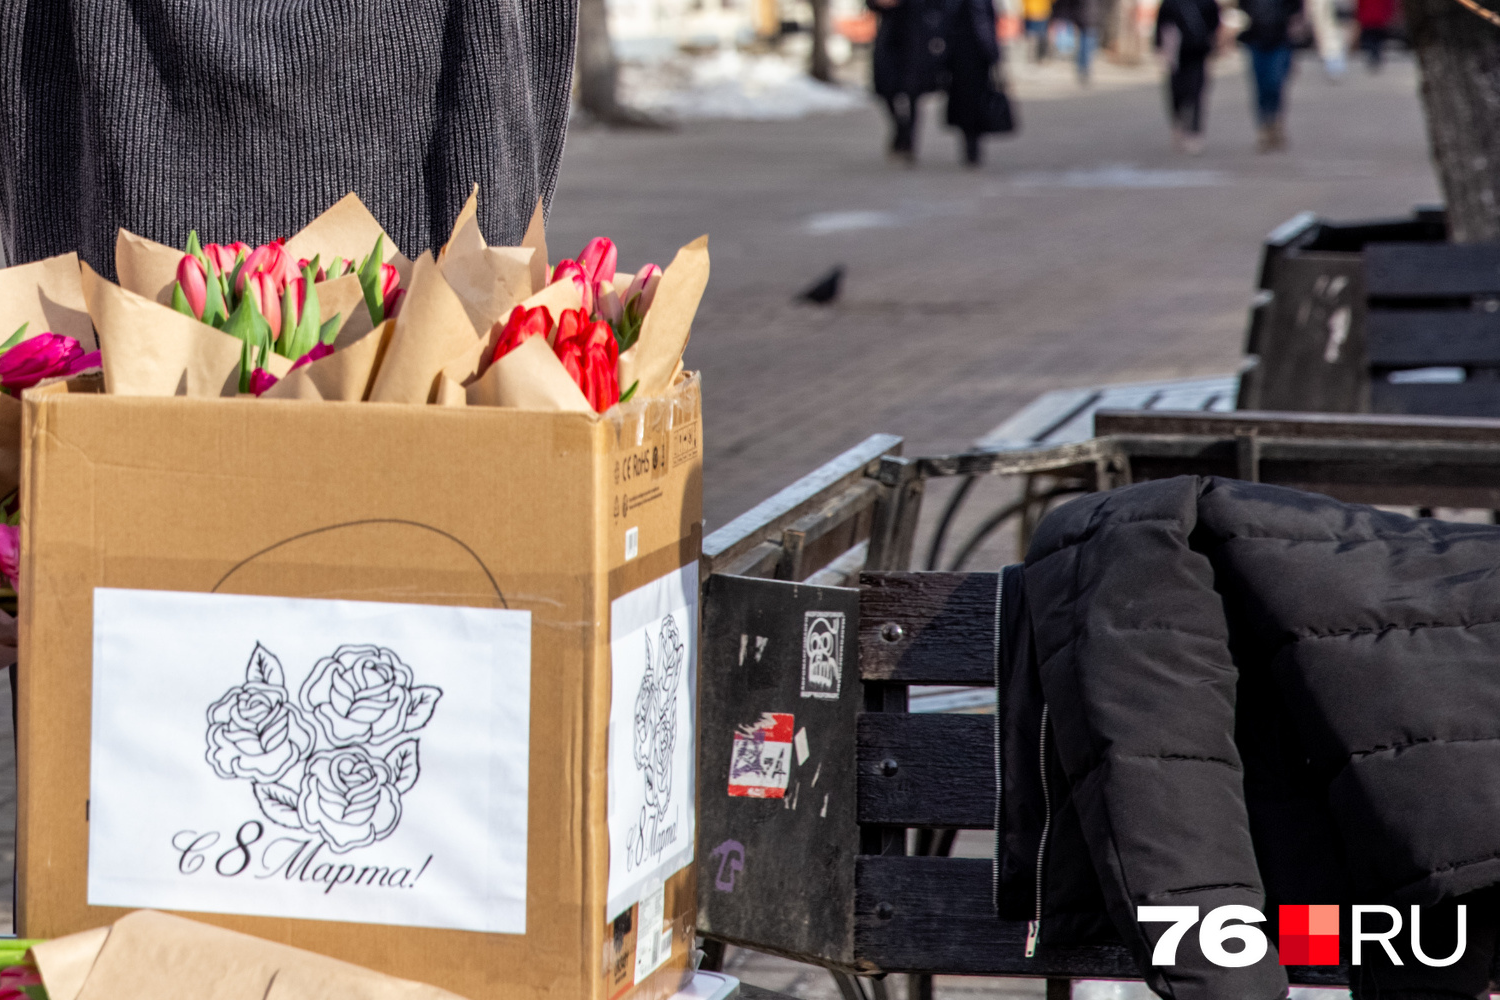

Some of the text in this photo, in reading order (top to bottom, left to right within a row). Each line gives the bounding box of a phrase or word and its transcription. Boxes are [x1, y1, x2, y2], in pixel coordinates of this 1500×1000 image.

[171, 820, 434, 894] С 8 Марта!
[635, 804, 647, 867] 8
